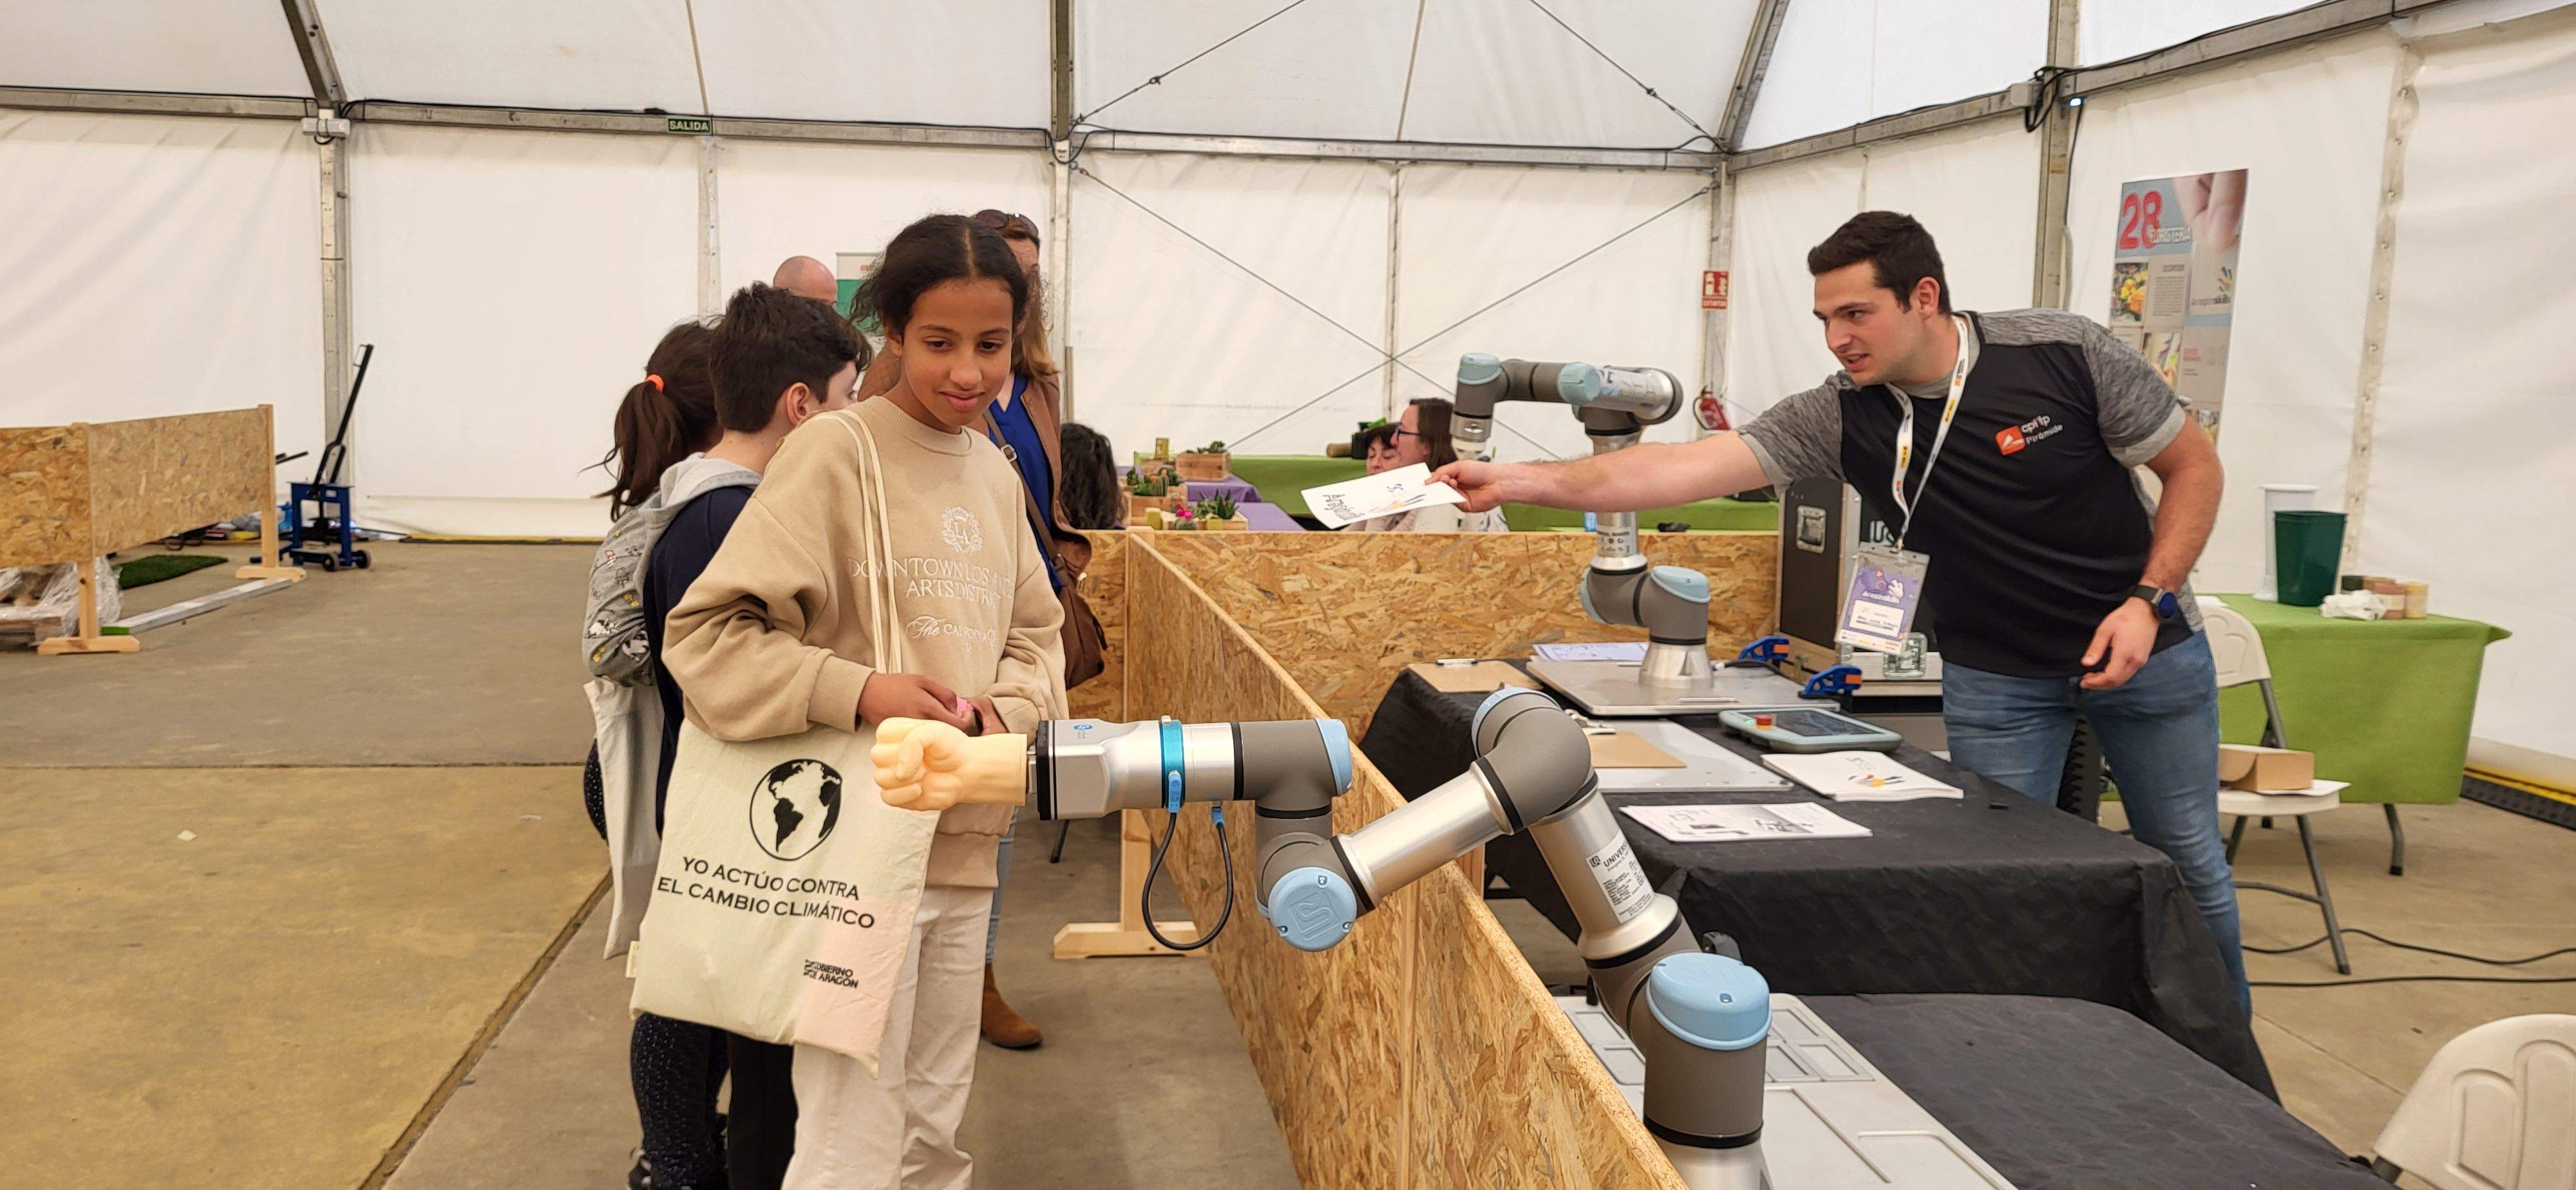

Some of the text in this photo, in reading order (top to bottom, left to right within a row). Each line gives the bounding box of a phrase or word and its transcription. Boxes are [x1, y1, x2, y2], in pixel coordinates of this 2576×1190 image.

[670, 120, 709, 131] SALIDA
[2119, 191, 2162, 249] 28
[905, 578, 1002, 608] ARTS DISTRIC
[905, 616, 945, 639] The
[683, 856, 859, 901] YO ACTÚO CONTRA
[658, 876, 875, 928] EL CAMBIO CLIMÁTICO
